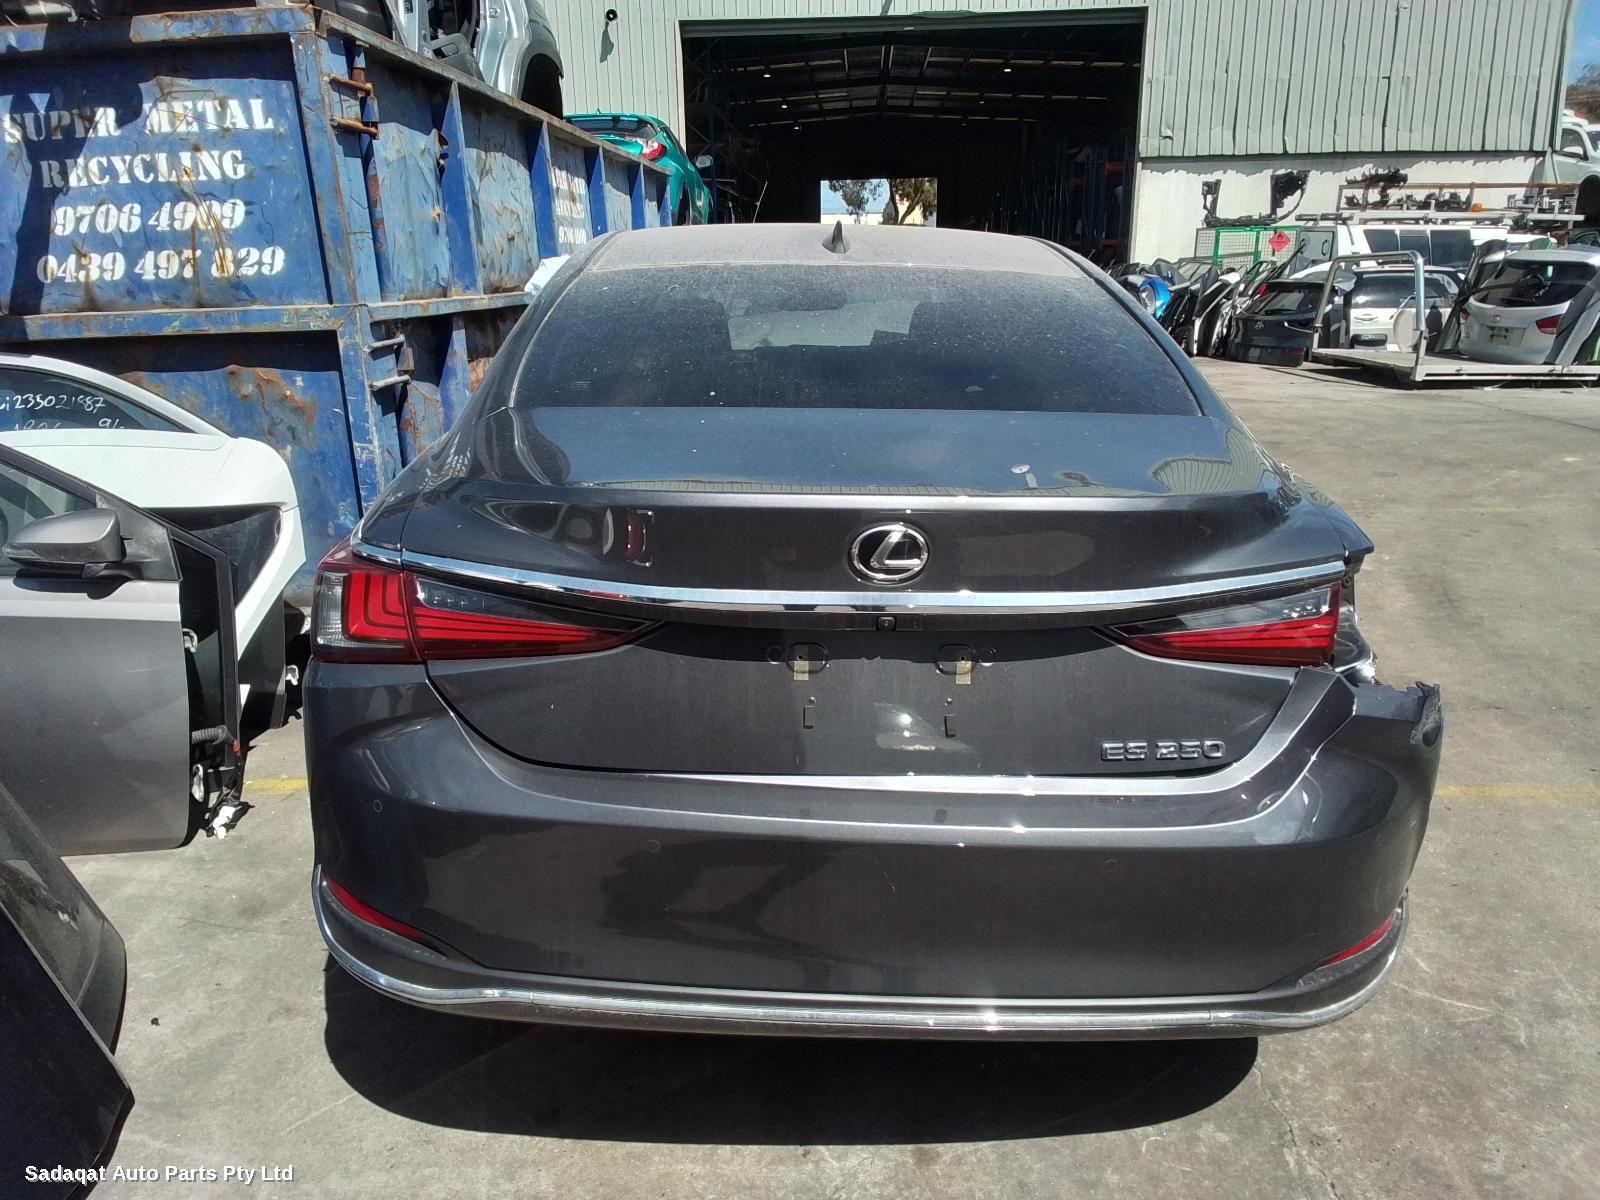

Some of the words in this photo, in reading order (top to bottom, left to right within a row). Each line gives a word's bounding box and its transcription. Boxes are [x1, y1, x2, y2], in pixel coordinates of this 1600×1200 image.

[144, 98, 274, 136] METAL
[40, 149, 246, 188] RECYCLING
[53, 203, 142, 236] 9706
[148, 199, 246, 231] 4909
[37, 252, 126, 284] 0439
[134, 249, 202, 280] 497
[210, 246, 285, 278] 829
[1101, 741, 1149, 761] ES
[1155, 740, 1226, 760] 250
